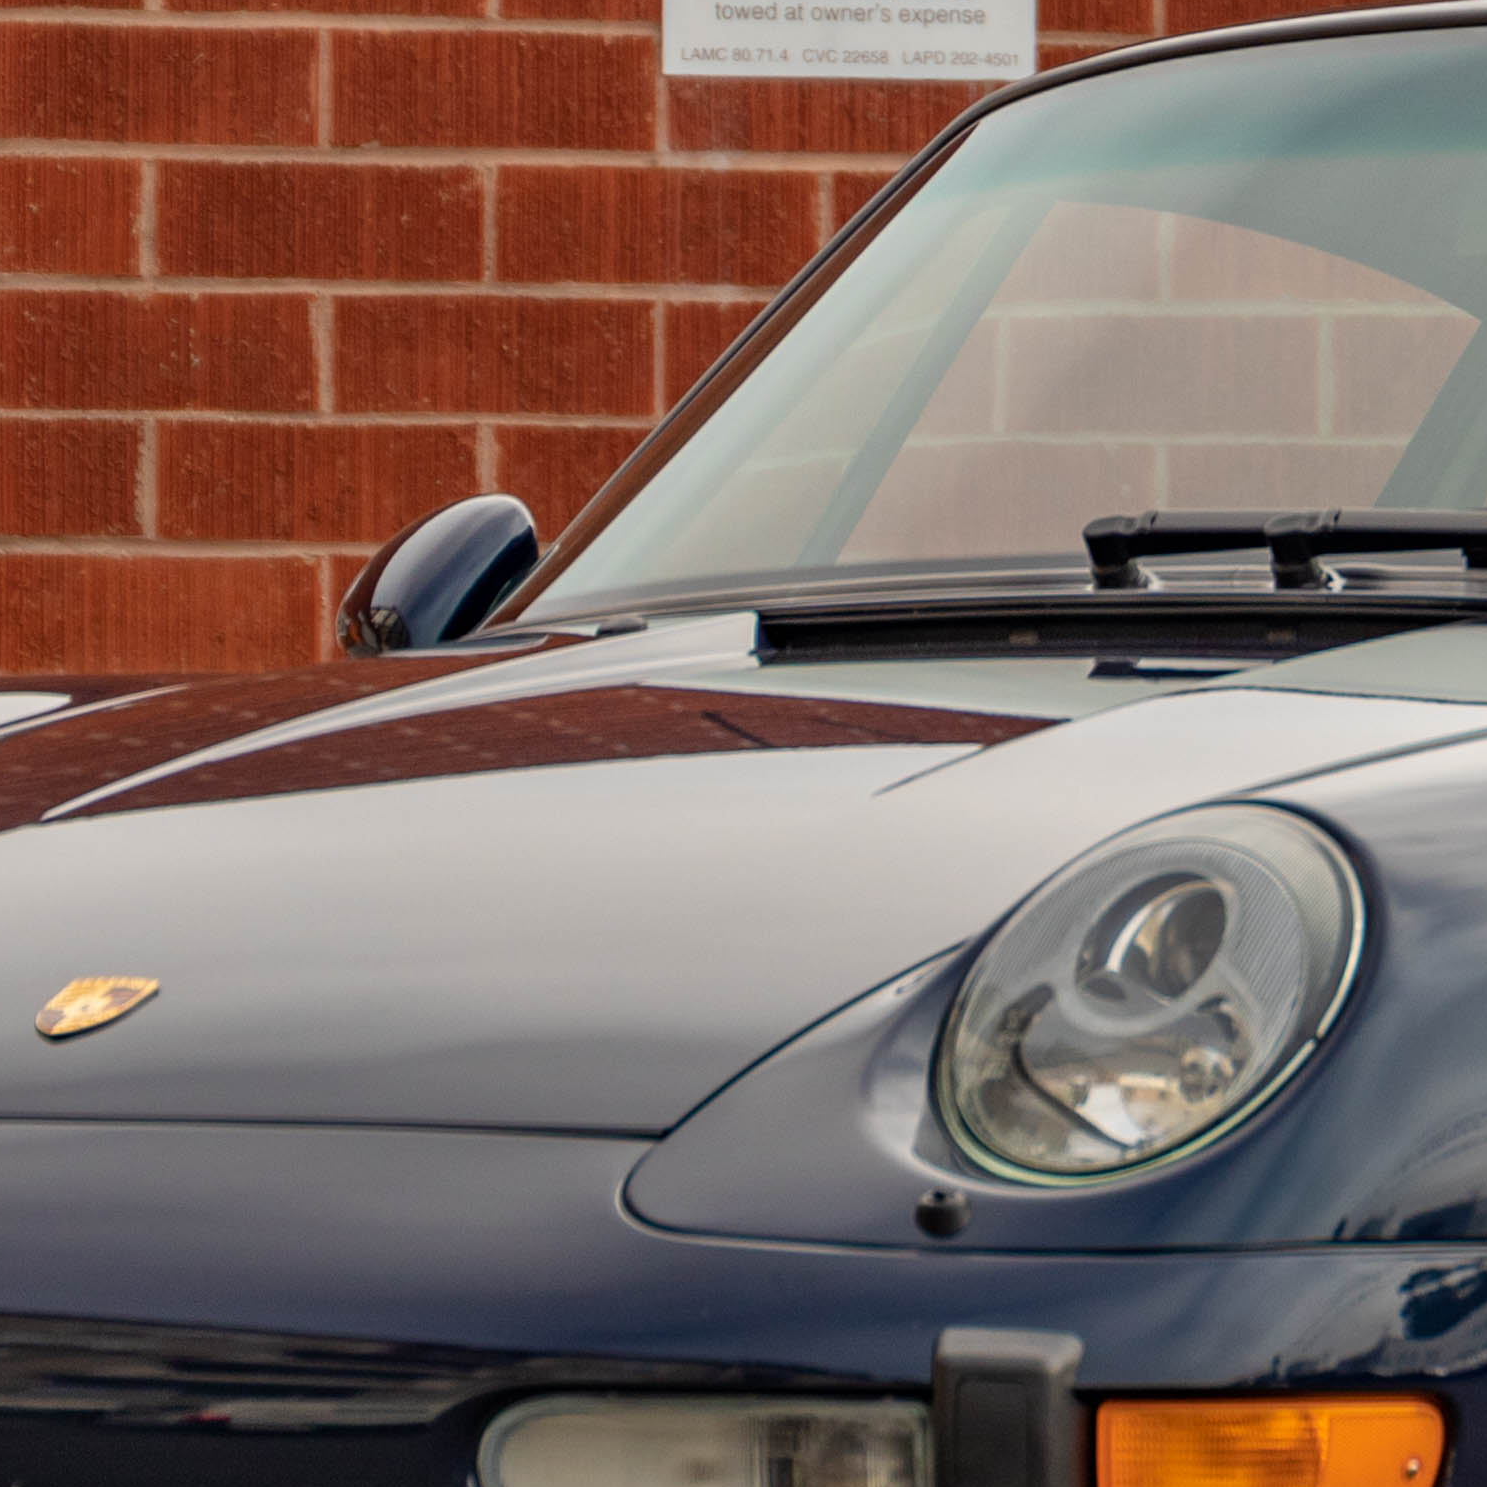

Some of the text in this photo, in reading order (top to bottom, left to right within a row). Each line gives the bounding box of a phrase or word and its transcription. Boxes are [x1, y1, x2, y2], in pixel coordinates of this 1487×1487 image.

[714, 2, 987, 28] towed at owner's expense
[680, 48, 727, 63] LAMC
[801, 49, 837, 64] CVC
[902, 50, 945, 66] LAPD
